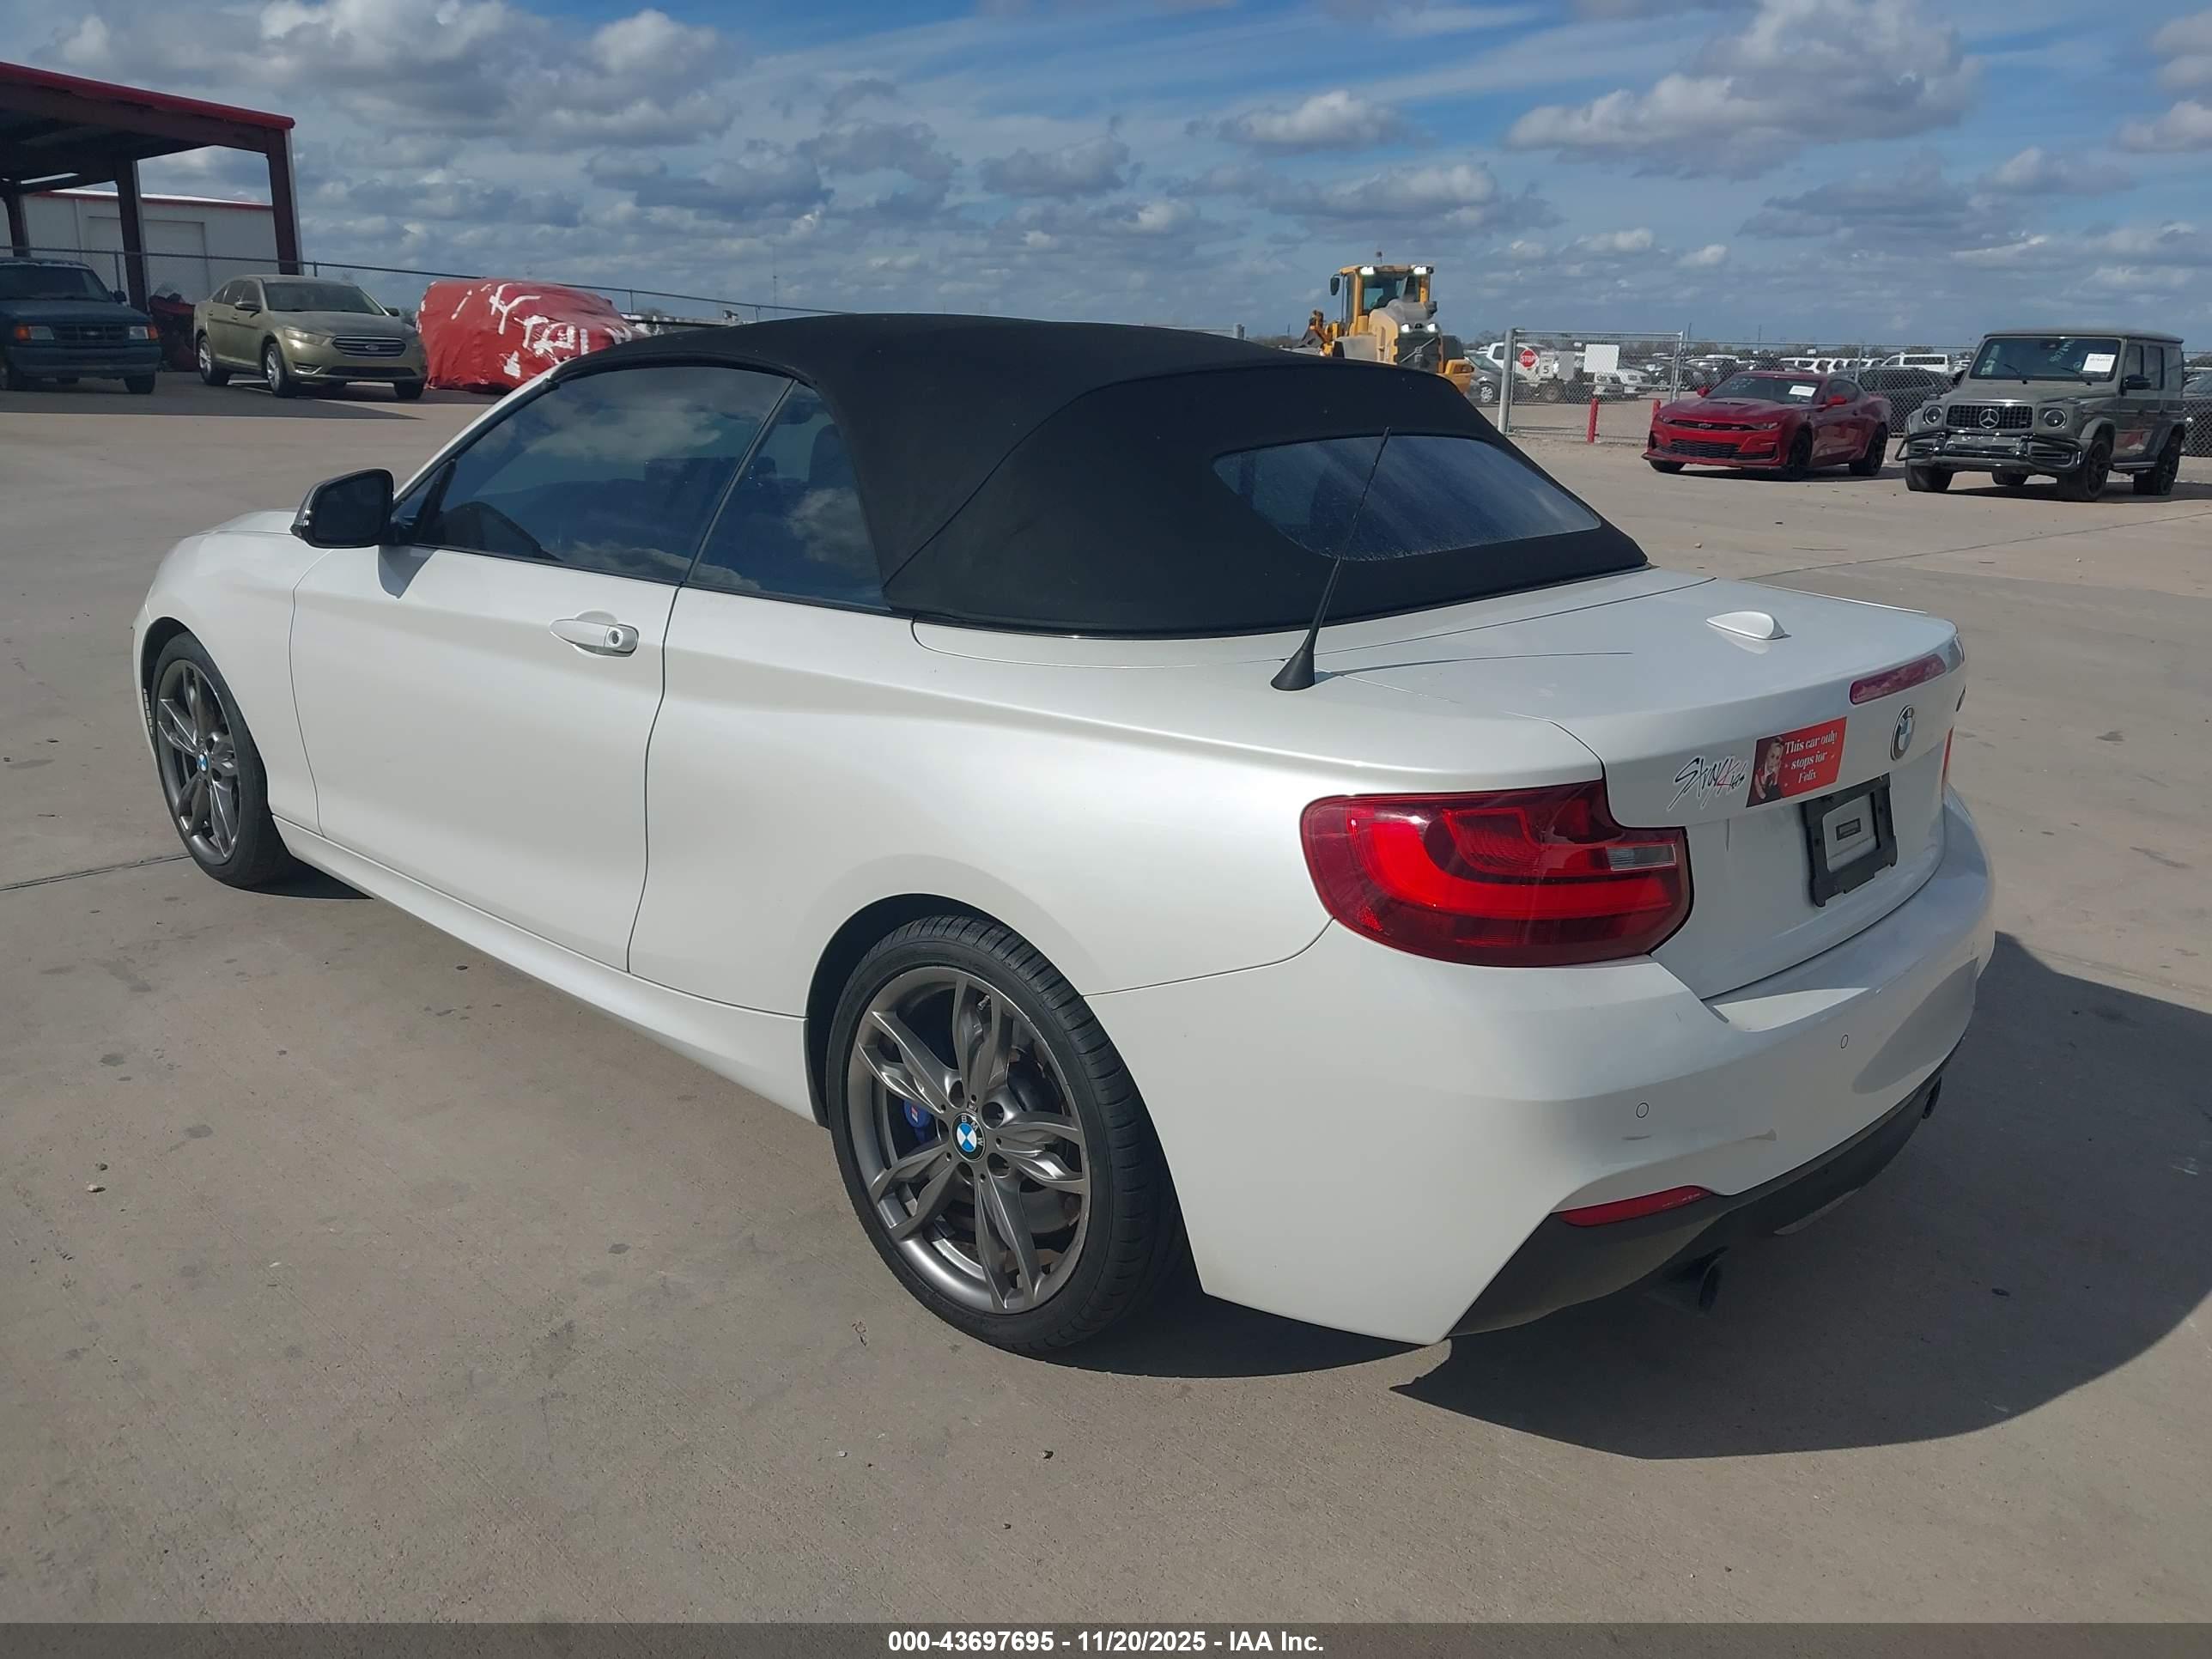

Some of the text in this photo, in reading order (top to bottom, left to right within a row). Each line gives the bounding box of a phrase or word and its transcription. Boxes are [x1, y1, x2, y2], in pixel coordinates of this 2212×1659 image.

[1543, 365, 1550, 374] 5
[1785, 730, 1838, 754] This car only
[1791, 750, 1827, 769] stops for
[1798, 769, 1816, 783] Felix
[961, 1115, 983, 1146] BMW
